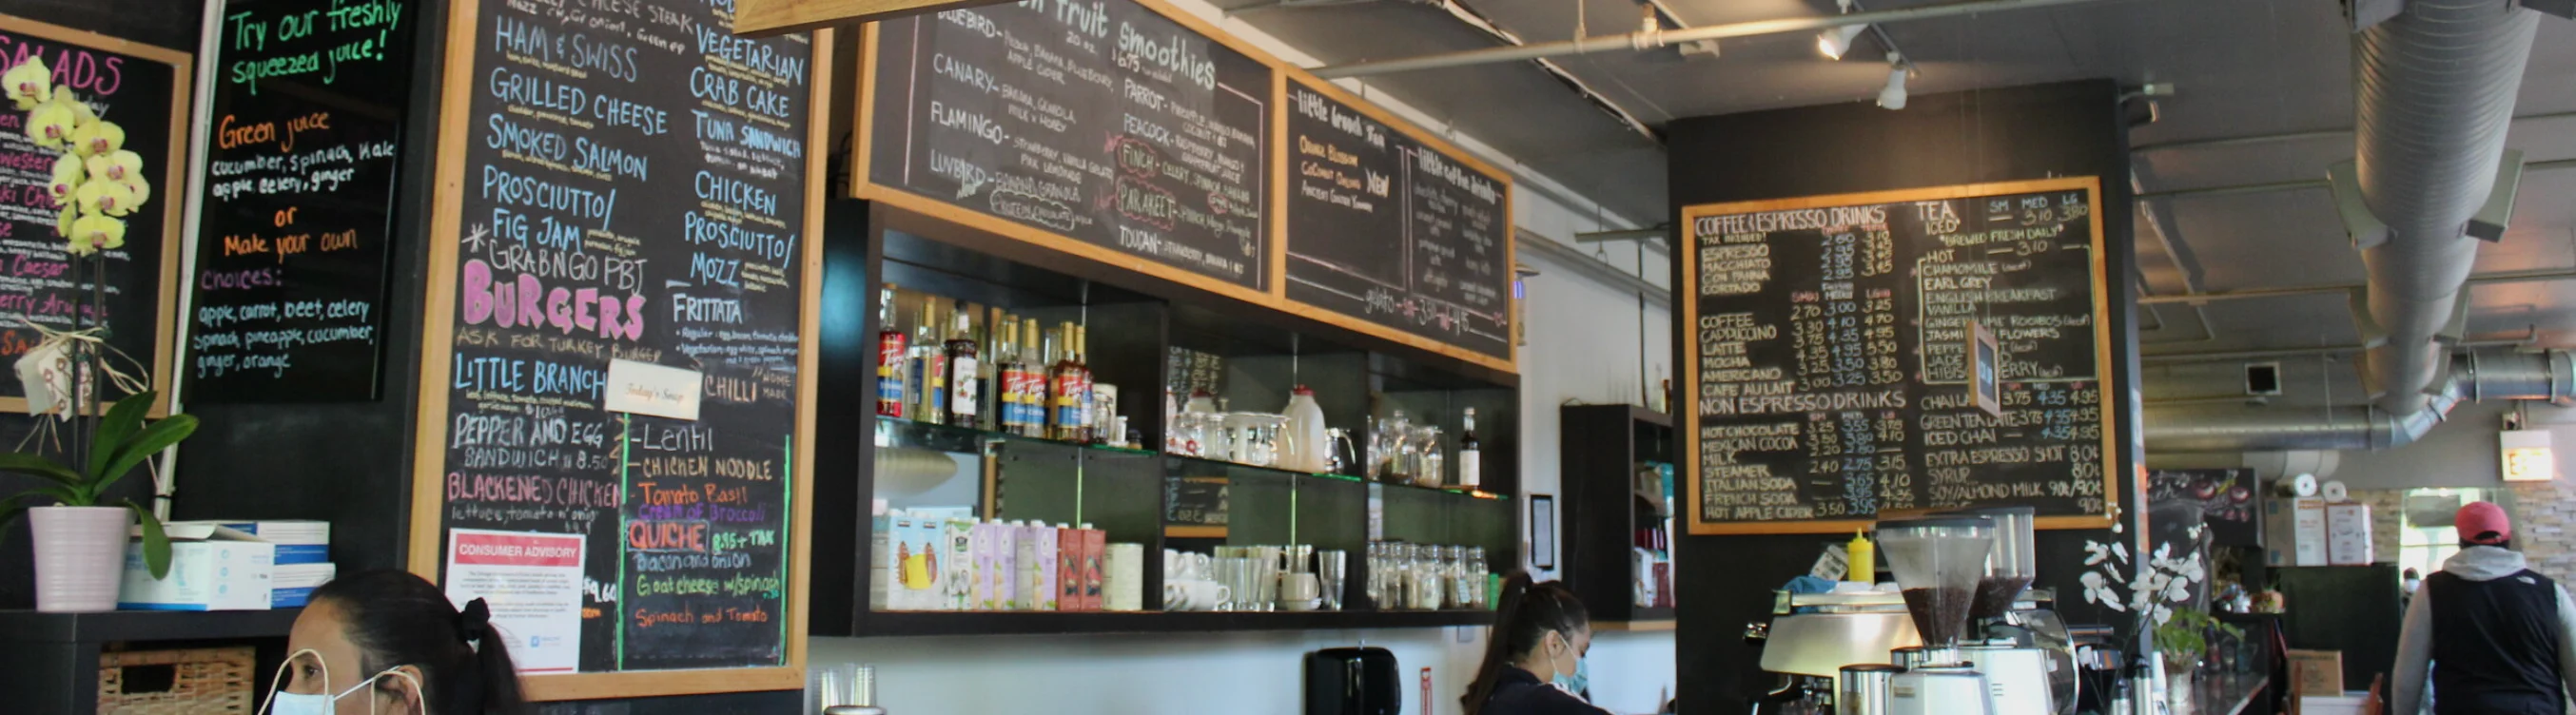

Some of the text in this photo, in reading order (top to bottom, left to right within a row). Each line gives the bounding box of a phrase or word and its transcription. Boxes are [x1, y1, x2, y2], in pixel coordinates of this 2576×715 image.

[228, 0, 401, 51] Try our freshly
[495, 15, 549, 62] HAM
[570, 33, 638, 83] SWISS
[696, 23, 805, 86] VEGETARIAN
[1119, 21, 1216, 90] smoothies
[232, 29, 387, 95] squeezed juice!
[490, 67, 587, 116] GRILLED
[594, 94, 668, 136] CHEESE
[690, 66, 739, 106] CRAB
[747, 86, 790, 118] CAKE
[219, 112, 330, 152] Green juice
[691, 108, 735, 143] TUNA
[739, 125, 801, 159] SANDWICH
[486, 113, 567, 162] SMOKED
[573, 137, 648, 181] SALMON
[211, 154, 286, 176] cucumber,
[289, 145, 353, 175] spinach,
[311, 167, 354, 190] ginger
[483, 164, 616, 231] PROSCIUTTO/
[694, 169, 776, 216] CHICKEN
[1915, 201, 1958, 222] TEA
[1989, 200, 2010, 213] SM
[2021, 196, 2048, 209] MED
[274, 206, 297, 227] or
[1695, 204, 1887, 237] COFFEE ESPRESSO DRINKS
[224, 228, 358, 264] Make your own
[536, 216, 582, 255] JAM
[684, 210, 795, 269] PROSCIUTTO/
[1989, 228, 2025, 243] FRESH
[1701, 244, 1769, 261] ESPRESSO
[1926, 249, 1955, 263] HOT
[604, 255, 649, 297] PBJ
[690, 251, 740, 287] MOZZ
[1922, 261, 1999, 277] CHAMOMILE
[1923, 276, 1993, 292] EARL GREY
[463, 259, 647, 341] BURGERS
[1924, 288, 2057, 304] ENGLISH BREAKFAST
[198, 298, 370, 328] apple, carrot, beet, celery
[673, 293, 743, 324] FRITTATA
[1926, 302, 1977, 317] VANILLA
[1700, 312, 1754, 329] COFFEE
[244, 329, 305, 351] pineapple,
[306, 325, 374, 345] cucumber,
[457, 326, 662, 362] ASK FOR TURKEY BURGER
[1699, 324, 1777, 343] CAPPUCCINO
[2000, 327, 2060, 339] FLOWERS
[1702, 341, 1747, 357] LATTE
[197, 354, 291, 378] ginger, orange
[1702, 357, 1750, 370] MOCHA
[1702, 367, 1783, 382] AMERICANO
[455, 353, 607, 400] LITTLE BRANCH
[704, 375, 757, 403] CHILLI
[1702, 383, 1739, 397] CAFE
[1699, 390, 1906, 415] NON ESPRESSO DRINKS
[451, 412, 603, 449] PEPPER AND EGG
[1703, 422, 1800, 438] HOT CHOCOLATE
[1920, 413, 1961, 431] GREEN
[1760, 435, 1798, 452] COCOA
[1923, 428, 1997, 447] ICED CHAI
[464, 448, 559, 468] SANDWICH
[1703, 452, 1737, 466] MILK
[1925, 445, 2066, 468] EXTRA ESPRESSO SHOT
[715, 457, 772, 480] NOODLE
[1704, 464, 1771, 478] STEAMER
[447, 471, 554, 504] BLACKENED
[637, 482, 748, 506] Tomato Basil
[1760, 476, 1797, 491] SODA
[2013, 481, 2044, 497] MILK
[1705, 491, 1797, 506] FRENCH SODA
[687, 503, 705, 520] of
[710, 504, 767, 521] Broccoli
[1705, 507, 1729, 520] HOT
[1734, 506, 1772, 520] APPLE
[629, 520, 706, 552] QUICHE
[459, 543, 576, 559] CONSUMER ADVISORY
[634, 551, 682, 571] Bacon
[676, 574, 720, 595] cheese
[635, 601, 768, 628] Spinach and Tomato
